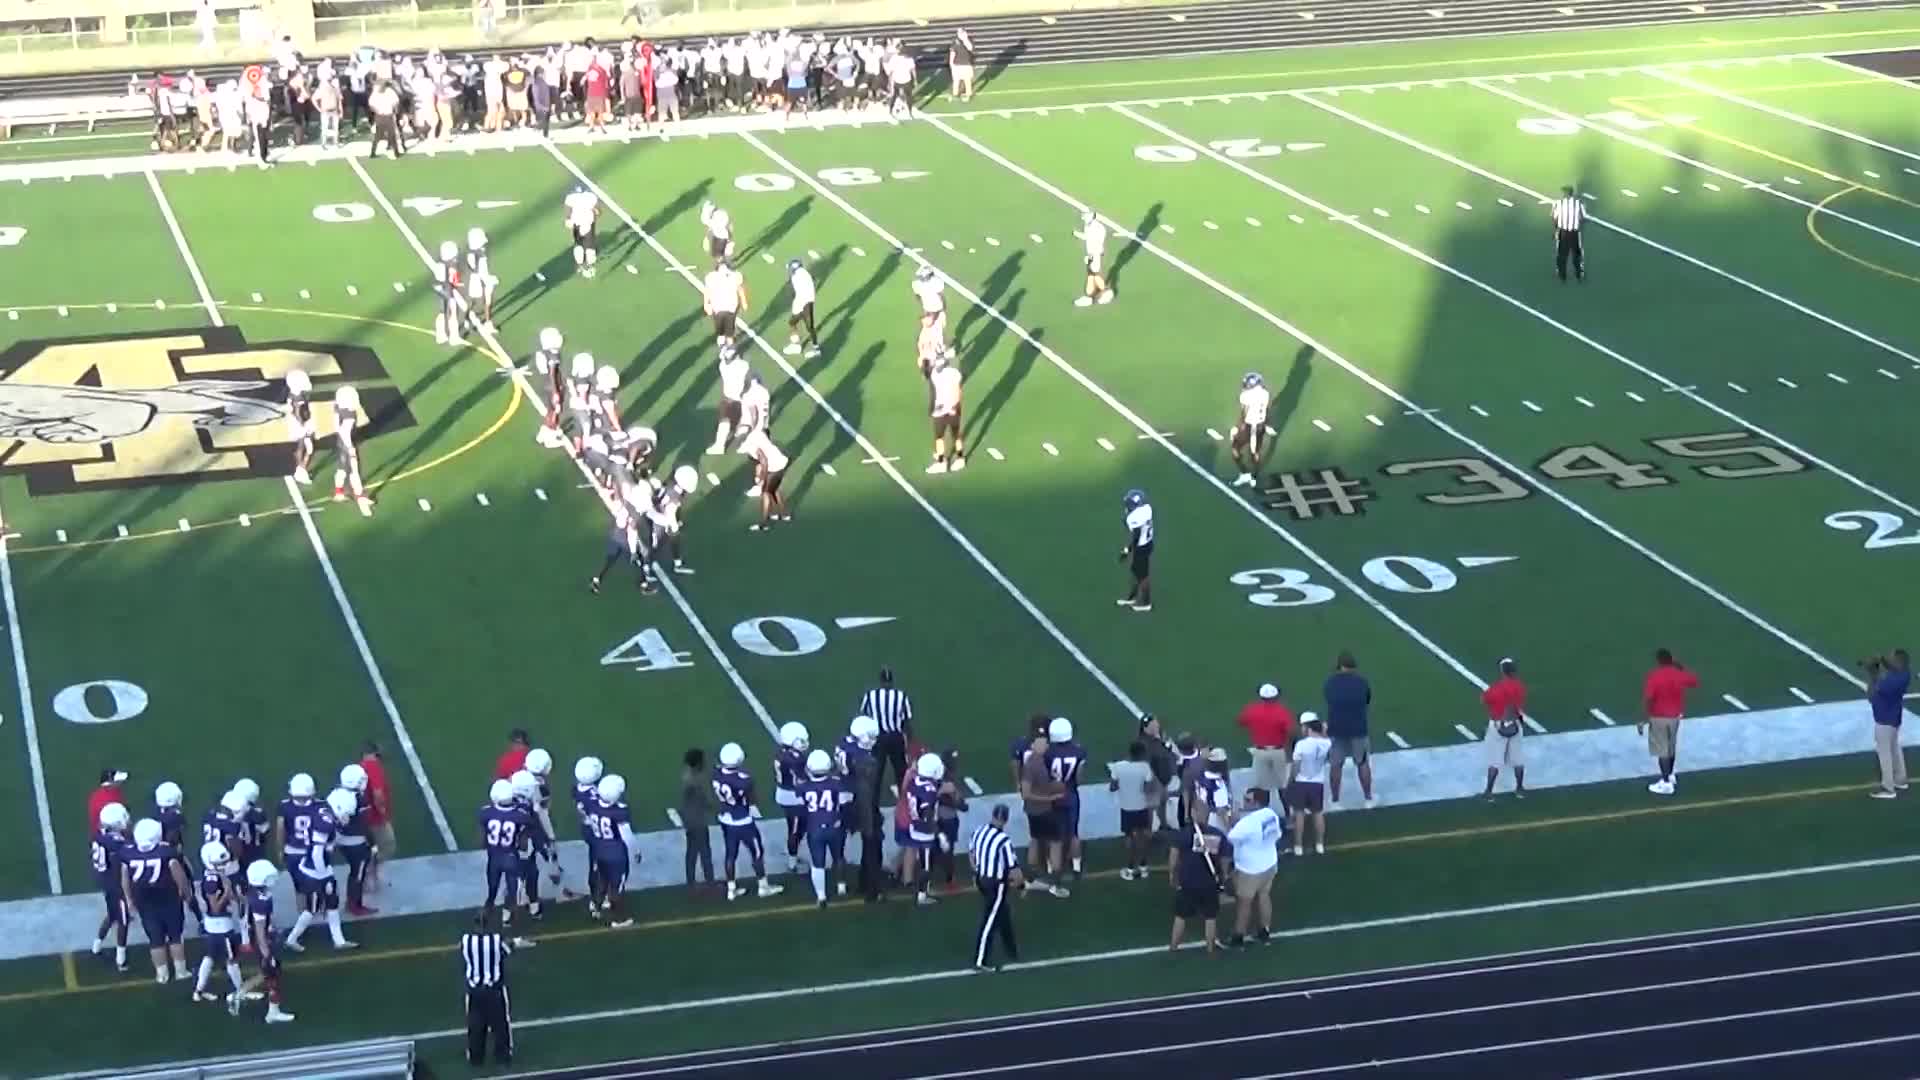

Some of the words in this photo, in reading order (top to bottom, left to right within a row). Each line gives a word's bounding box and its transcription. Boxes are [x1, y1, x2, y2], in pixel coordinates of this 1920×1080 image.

[1260, 431, 1810, 520] #345
[1229, 556, 1458, 607] 30
[600, 616, 828, 672] 40
[1051, 756, 1078, 782] 47
[805, 789, 835, 813] 34
[487, 818, 516, 847] 33
[129, 858, 162, 884] 77
